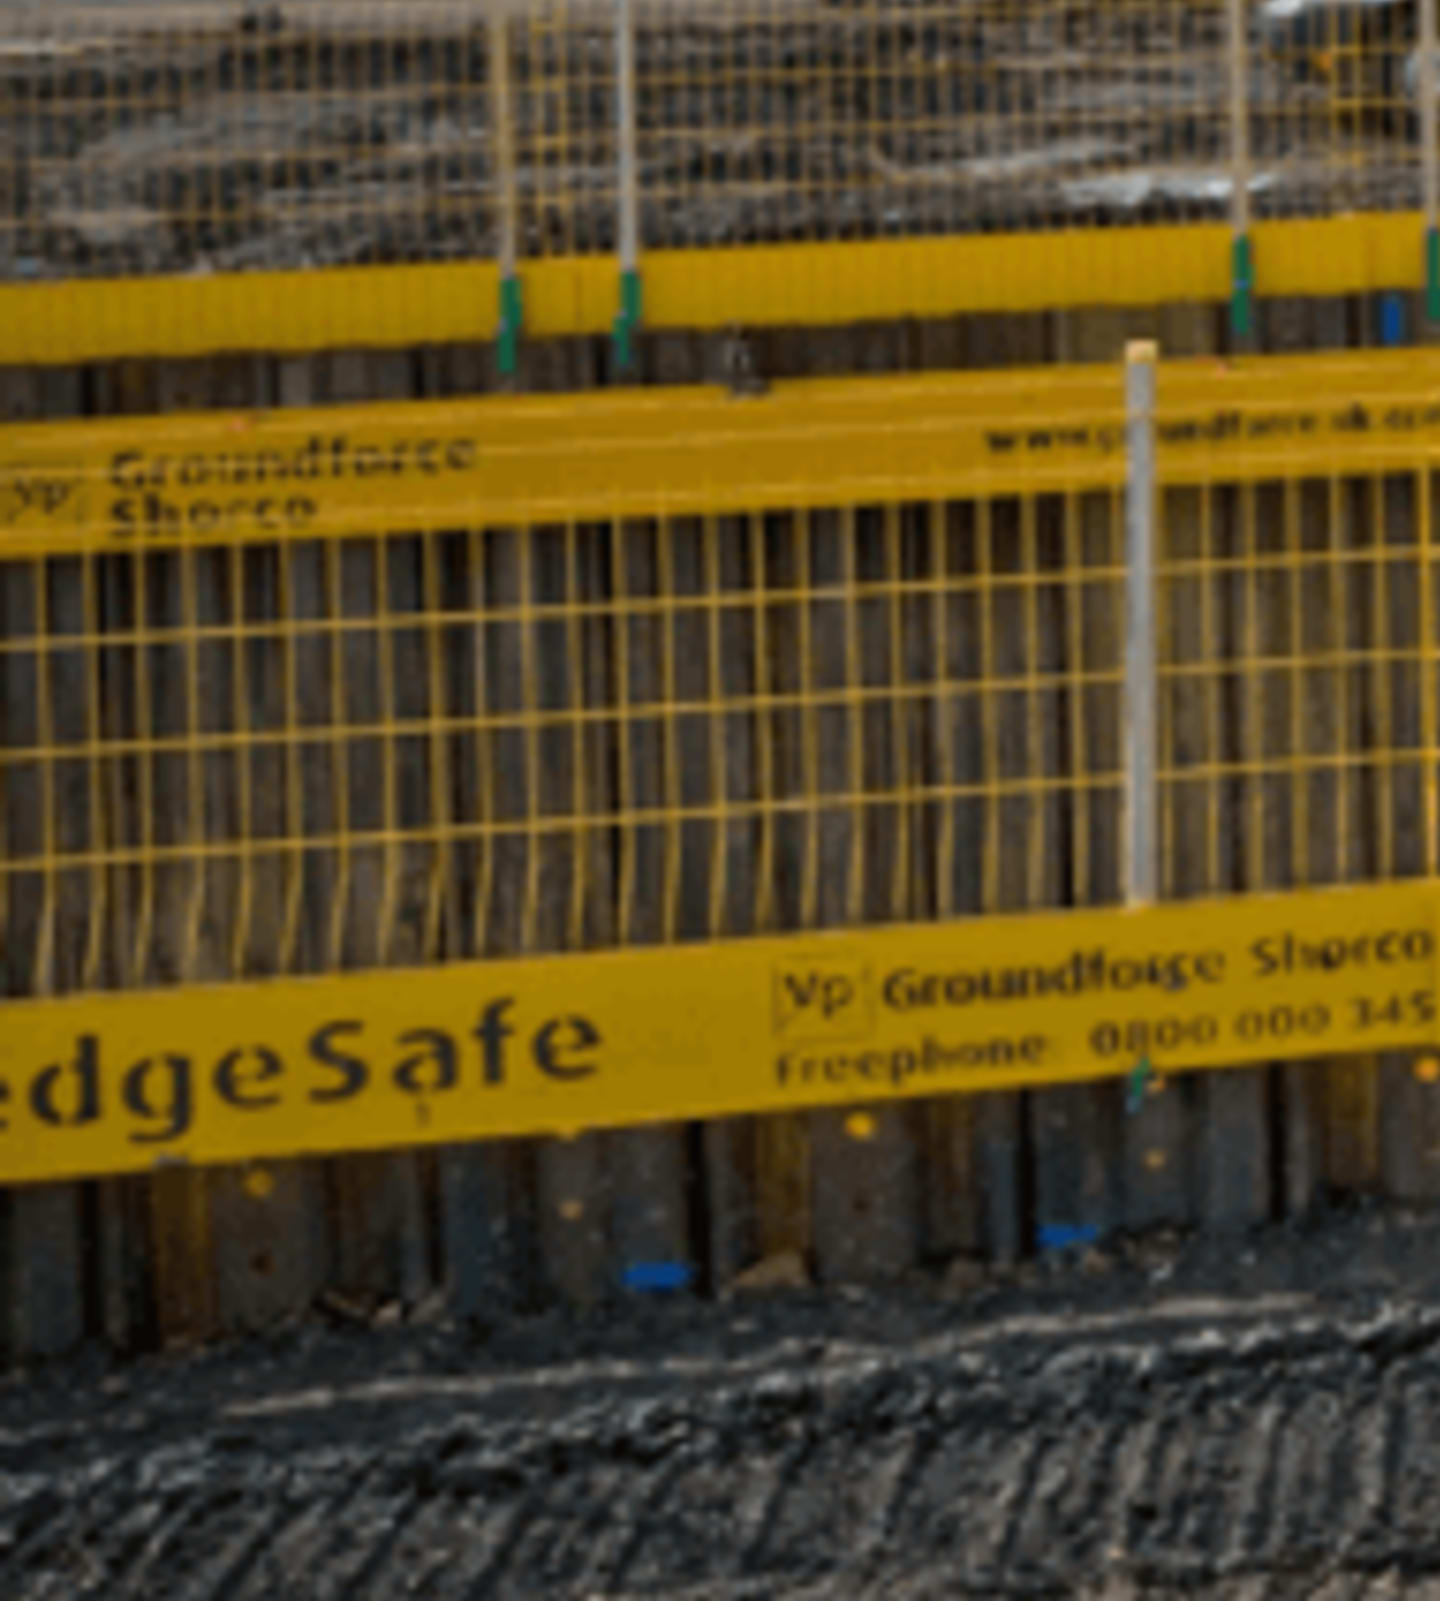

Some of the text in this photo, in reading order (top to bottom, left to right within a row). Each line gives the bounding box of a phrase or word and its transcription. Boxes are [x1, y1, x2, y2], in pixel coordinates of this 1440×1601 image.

[111, 435, 479, 491] Groundforce
[781, 926, 1435, 1017] Vp Groundforce Shorco
[0, 997, 603, 1145] dgeSafe
[776, 991, 1435, 1087] Freephone 0800 000 345
